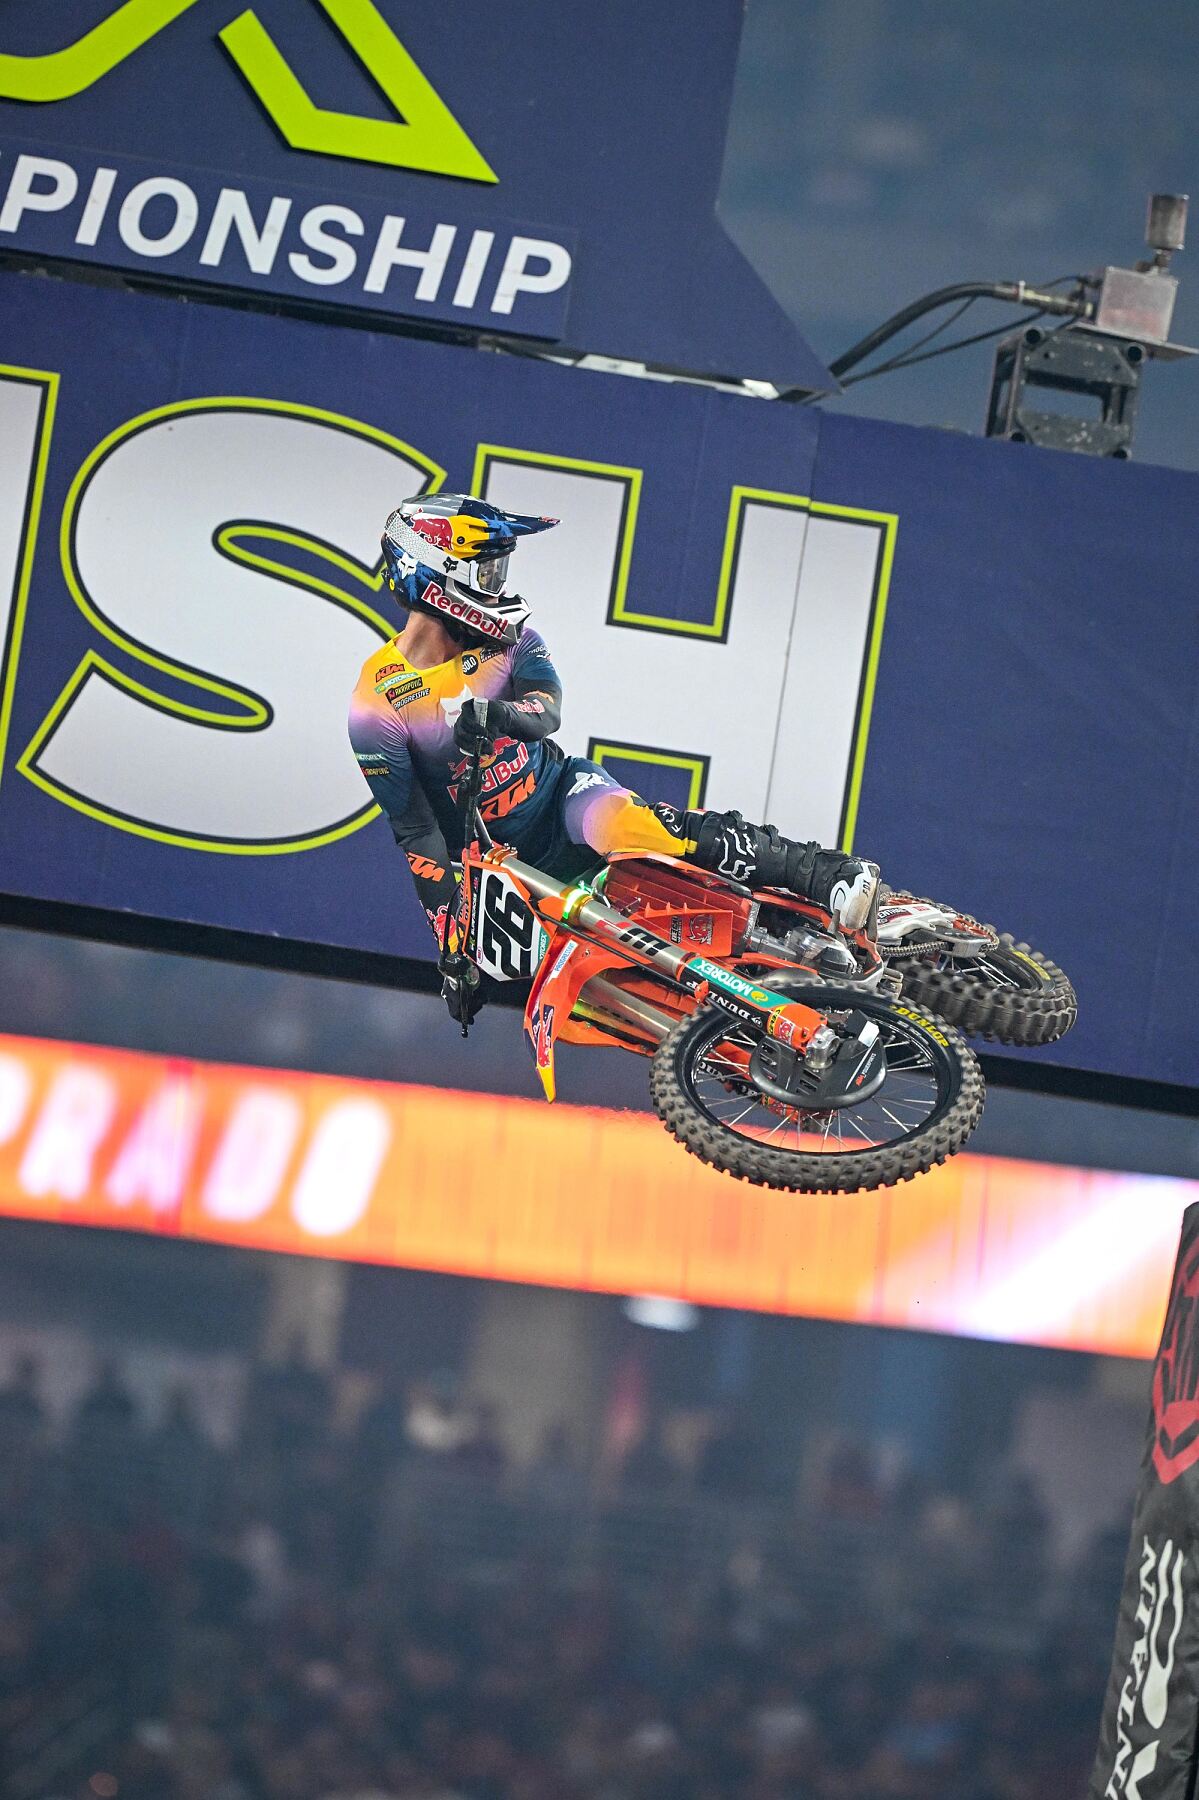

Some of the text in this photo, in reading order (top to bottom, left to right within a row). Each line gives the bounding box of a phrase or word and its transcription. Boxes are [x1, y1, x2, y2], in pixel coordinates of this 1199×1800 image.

[0, 152, 573, 315] PIONSHIP
[375, 663, 405, 683] KTM
[497, 742, 530, 784] Bull
[479, 771, 537, 822] KTM
[482, 873, 537, 980] 26
[685, 979, 751, 1020] DUNLP
[695, 959, 754, 999] MOTOREX
[896, 1006, 950, 1049] DUNLOP
